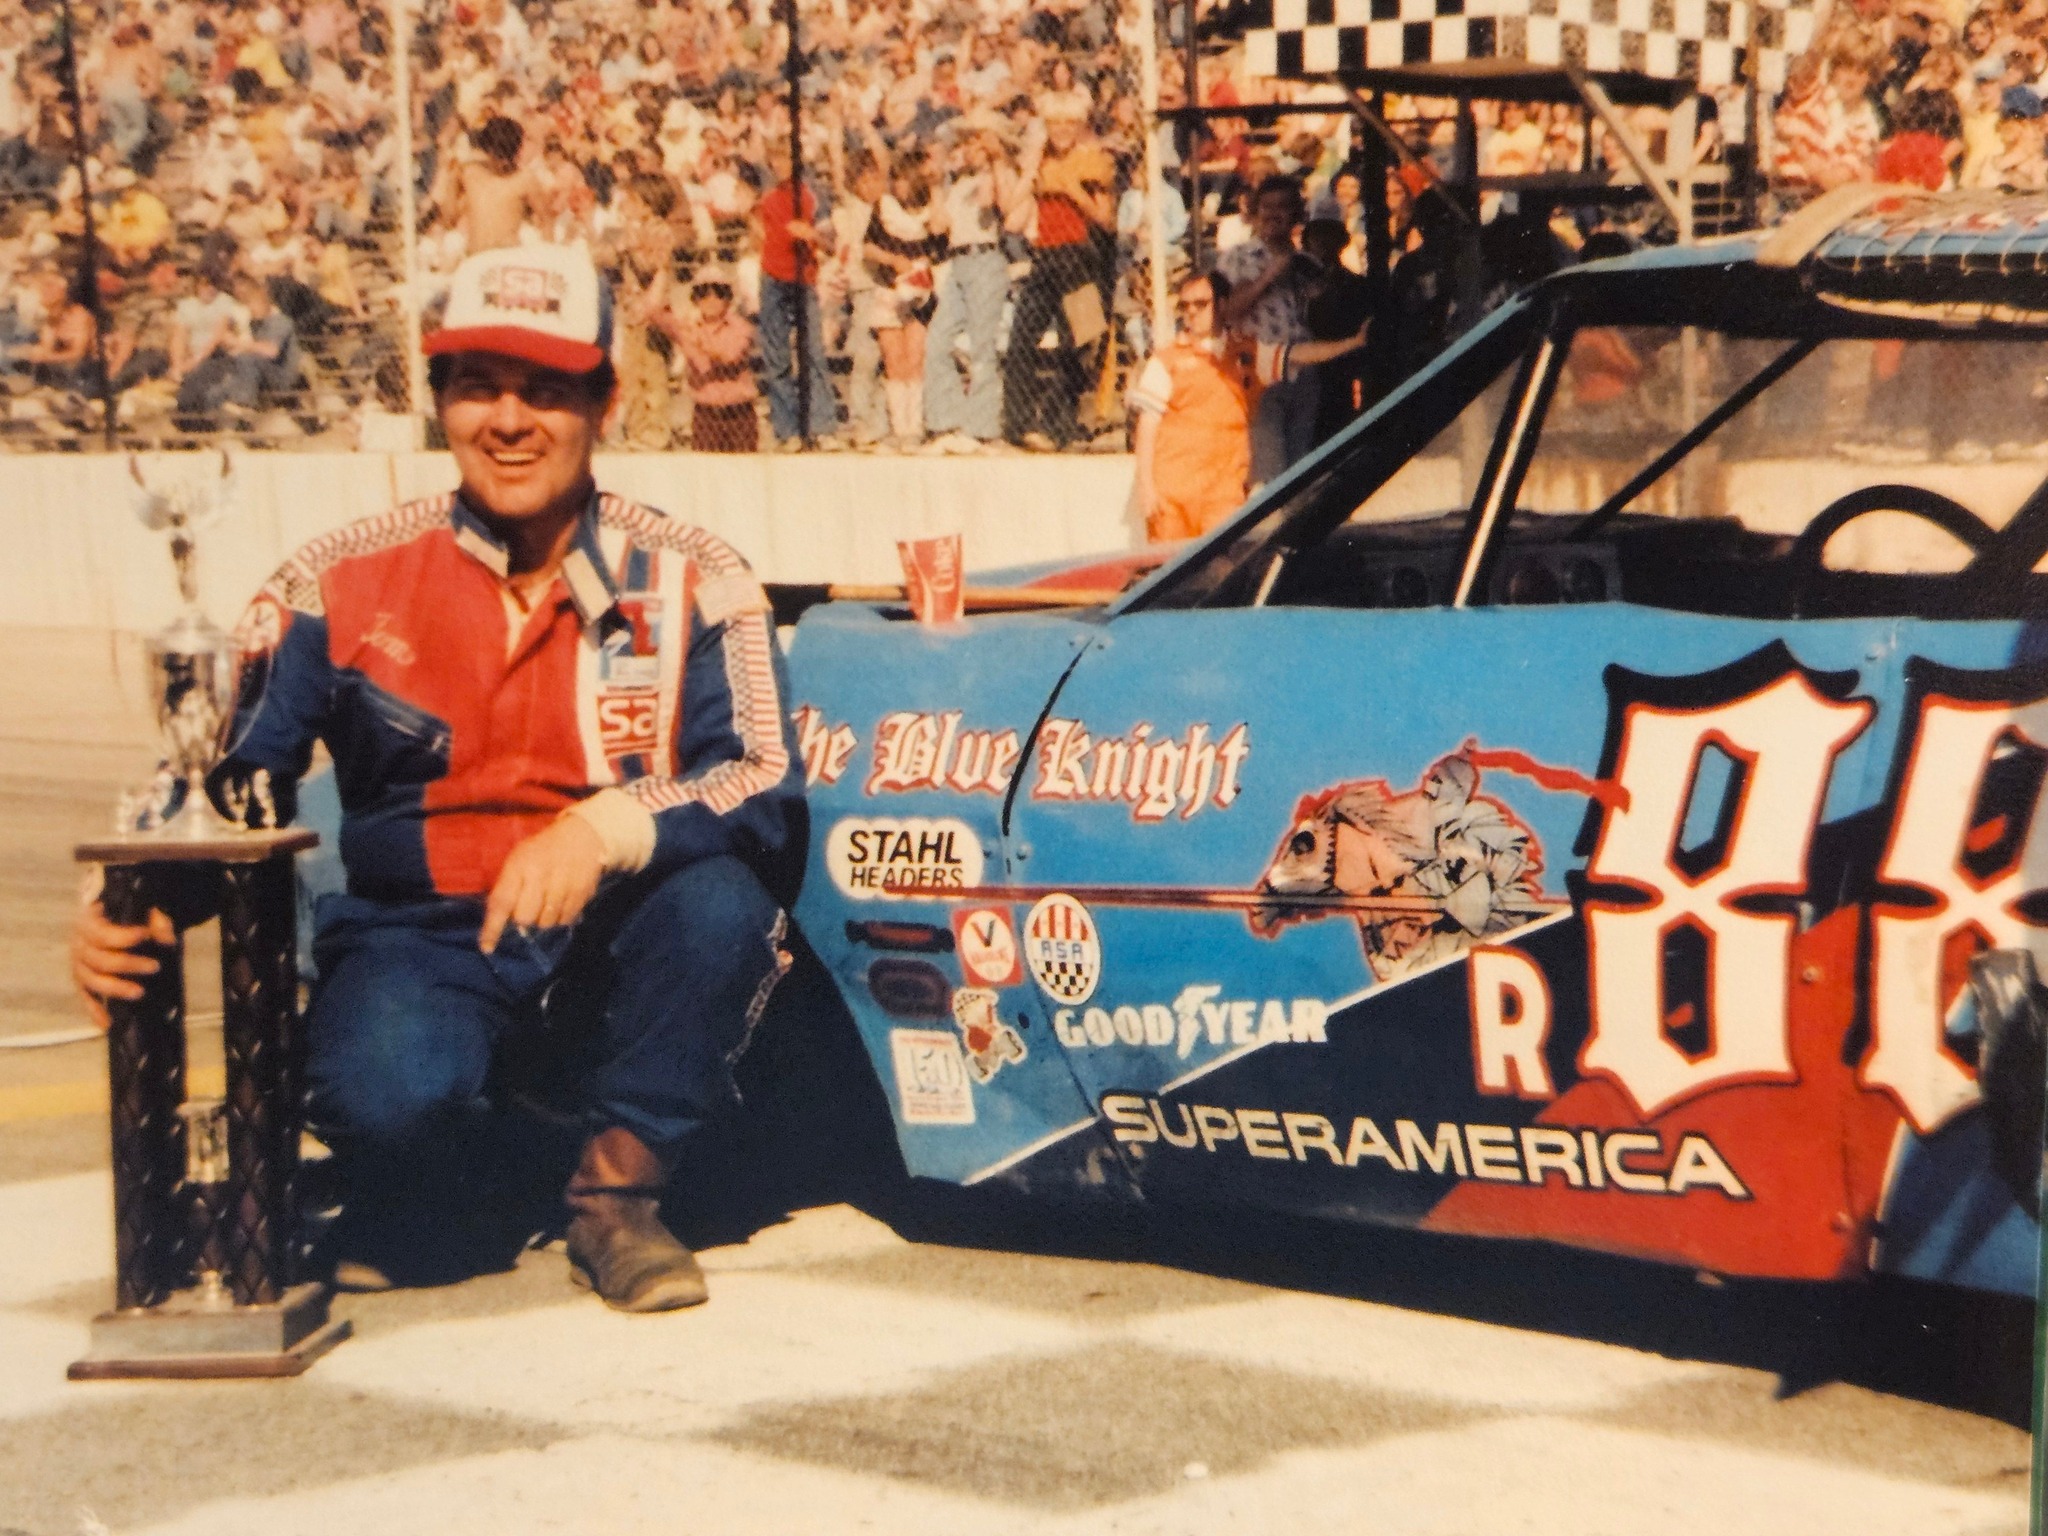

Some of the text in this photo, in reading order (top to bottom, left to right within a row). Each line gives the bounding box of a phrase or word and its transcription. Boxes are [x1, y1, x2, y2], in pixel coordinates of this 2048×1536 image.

[791, 704, 1250, 824] he Blue Knight
[847, 829, 963, 864] STAHL
[850, 866, 964, 889] HEADERS
[1040, 939, 1084, 962] ASA
[1054, 996, 1328, 1050] GOODYEAR
[1469, 944, 1557, 1100] R
[1101, 1094, 1748, 1199] SUPERAMERICA
